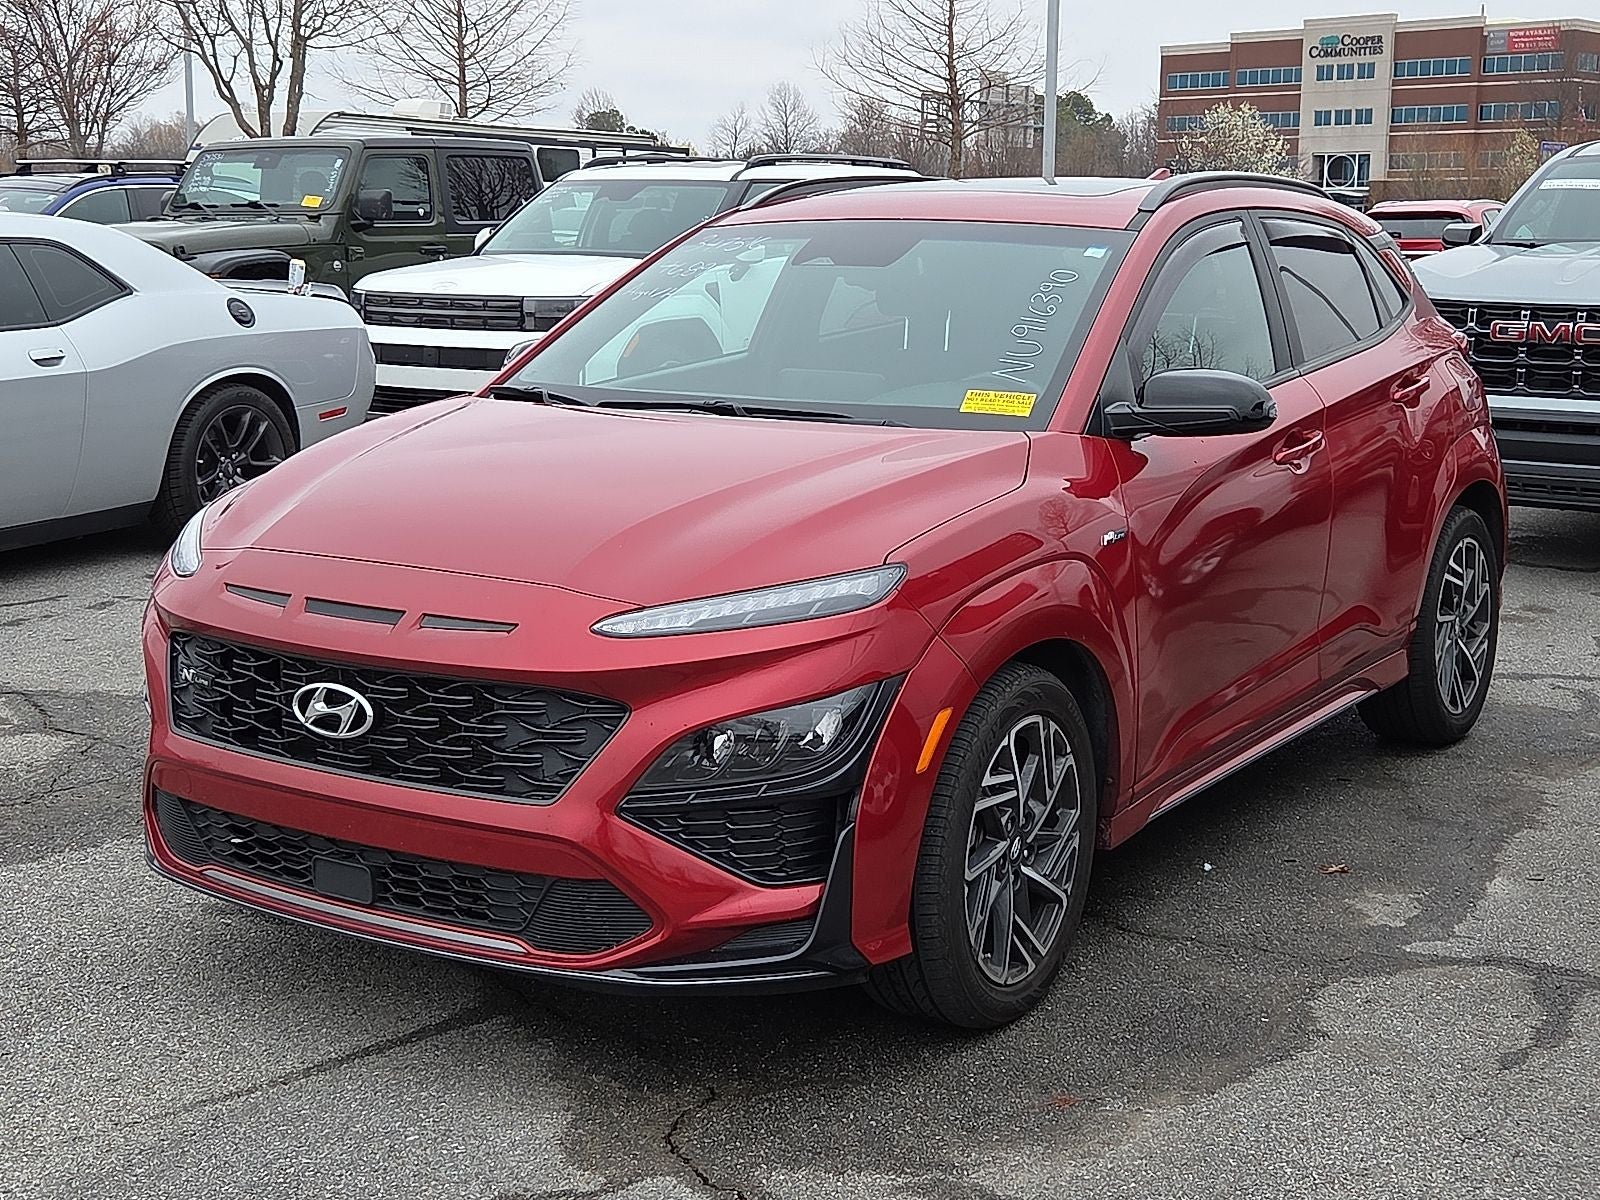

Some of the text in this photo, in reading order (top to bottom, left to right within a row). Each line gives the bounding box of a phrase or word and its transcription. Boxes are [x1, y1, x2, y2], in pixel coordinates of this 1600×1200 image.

[1341, 34, 1384, 47] COOPER
[1309, 45, 1384, 59] COMMUNITIES
[991, 268, 1080, 384] NU916390
[1489, 320, 1600, 345] GMC
[994, 392, 1034, 401] VEHICLE
